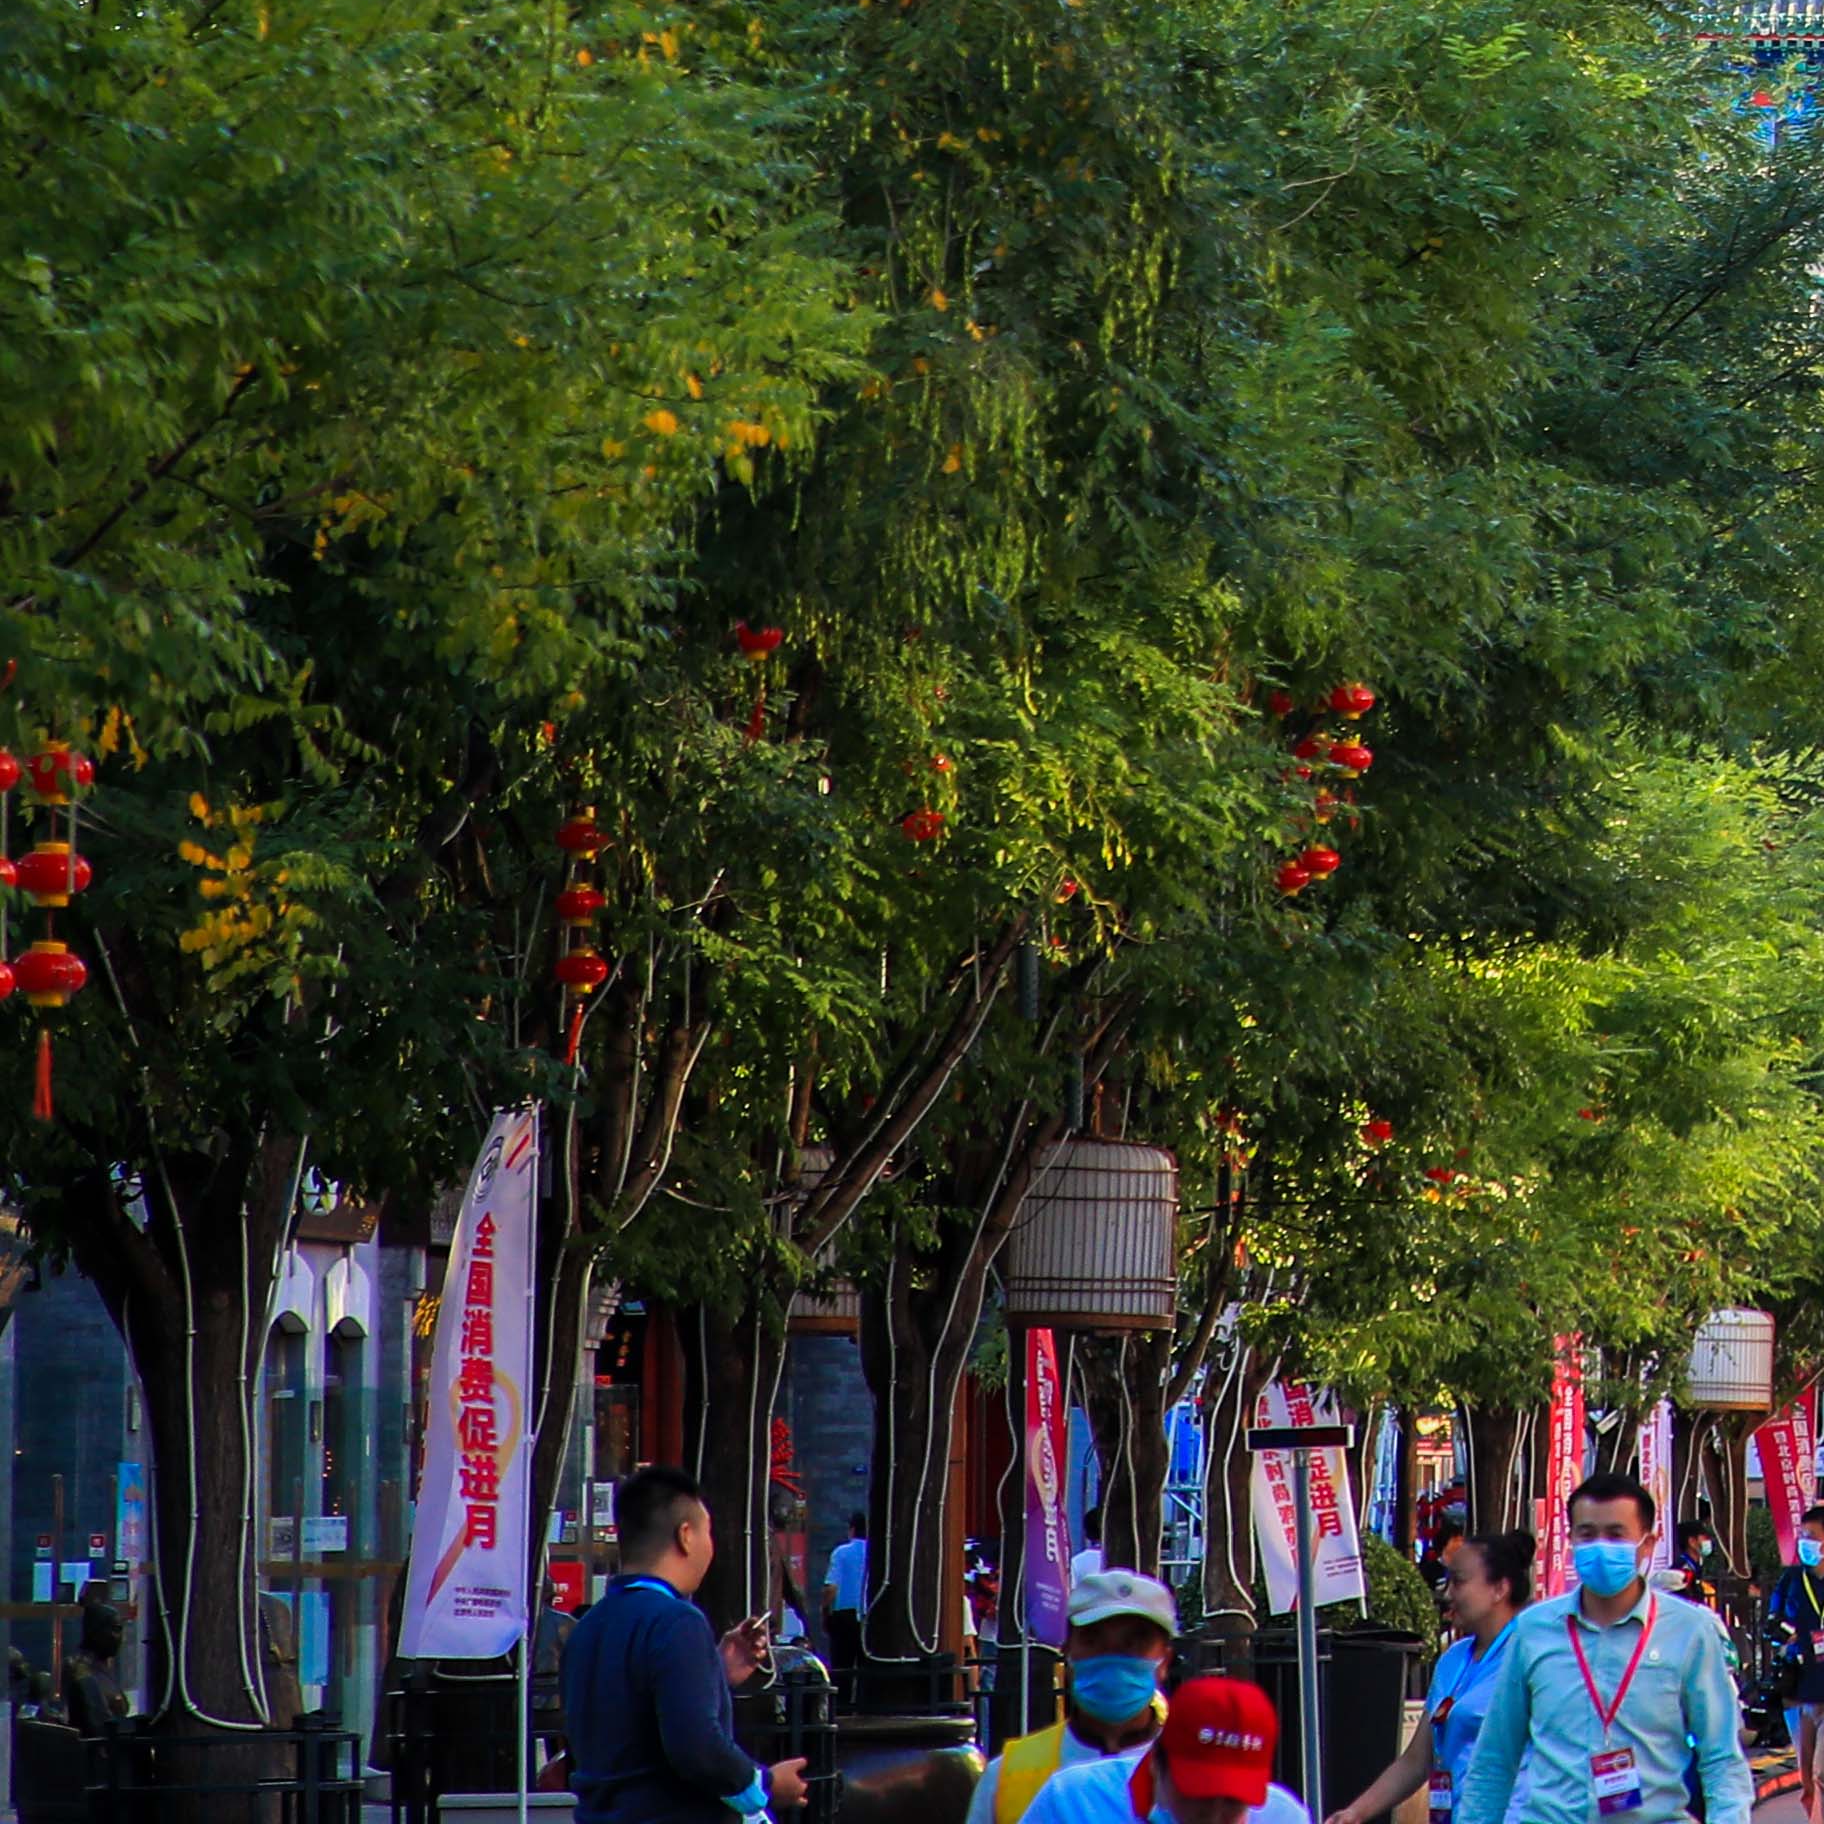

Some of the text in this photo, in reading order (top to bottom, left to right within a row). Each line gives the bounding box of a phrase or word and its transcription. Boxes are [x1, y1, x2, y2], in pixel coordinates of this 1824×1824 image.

[458, 1211, 499, 1550] 全国消费促进月
